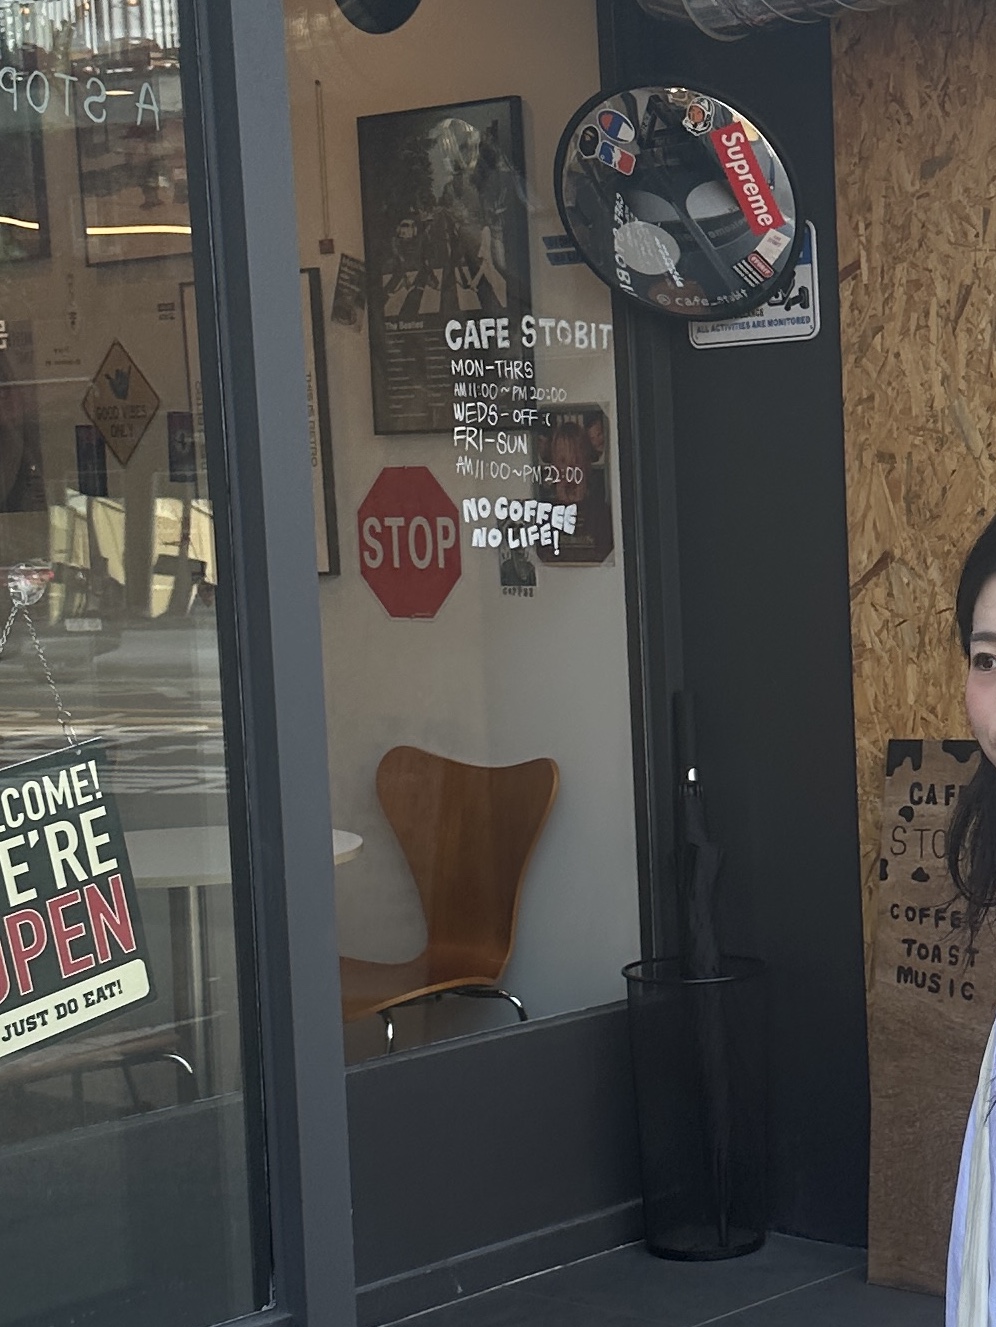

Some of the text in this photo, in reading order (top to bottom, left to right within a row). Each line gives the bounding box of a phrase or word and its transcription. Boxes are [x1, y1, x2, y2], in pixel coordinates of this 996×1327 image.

[721, 131, 775, 228] Supreme
[445, 315, 613, 351] CAFE STOBIT
[462, 496, 578, 535] NO COFFEE
[362, 515, 457, 570] STOP
[471, 524, 561, 556] NO LIFE!
[0, 759, 103, 832] COME!
[0, 805, 118, 907] E'RE
[0, 873, 137, 1001] PEN
[890, 903, 962, 929] COFFE
[902, 938, 979, 968] TOAST
[896, 965, 975, 1001] MUSIC
[2, 978, 124, 1043] JUST DO EAT!
